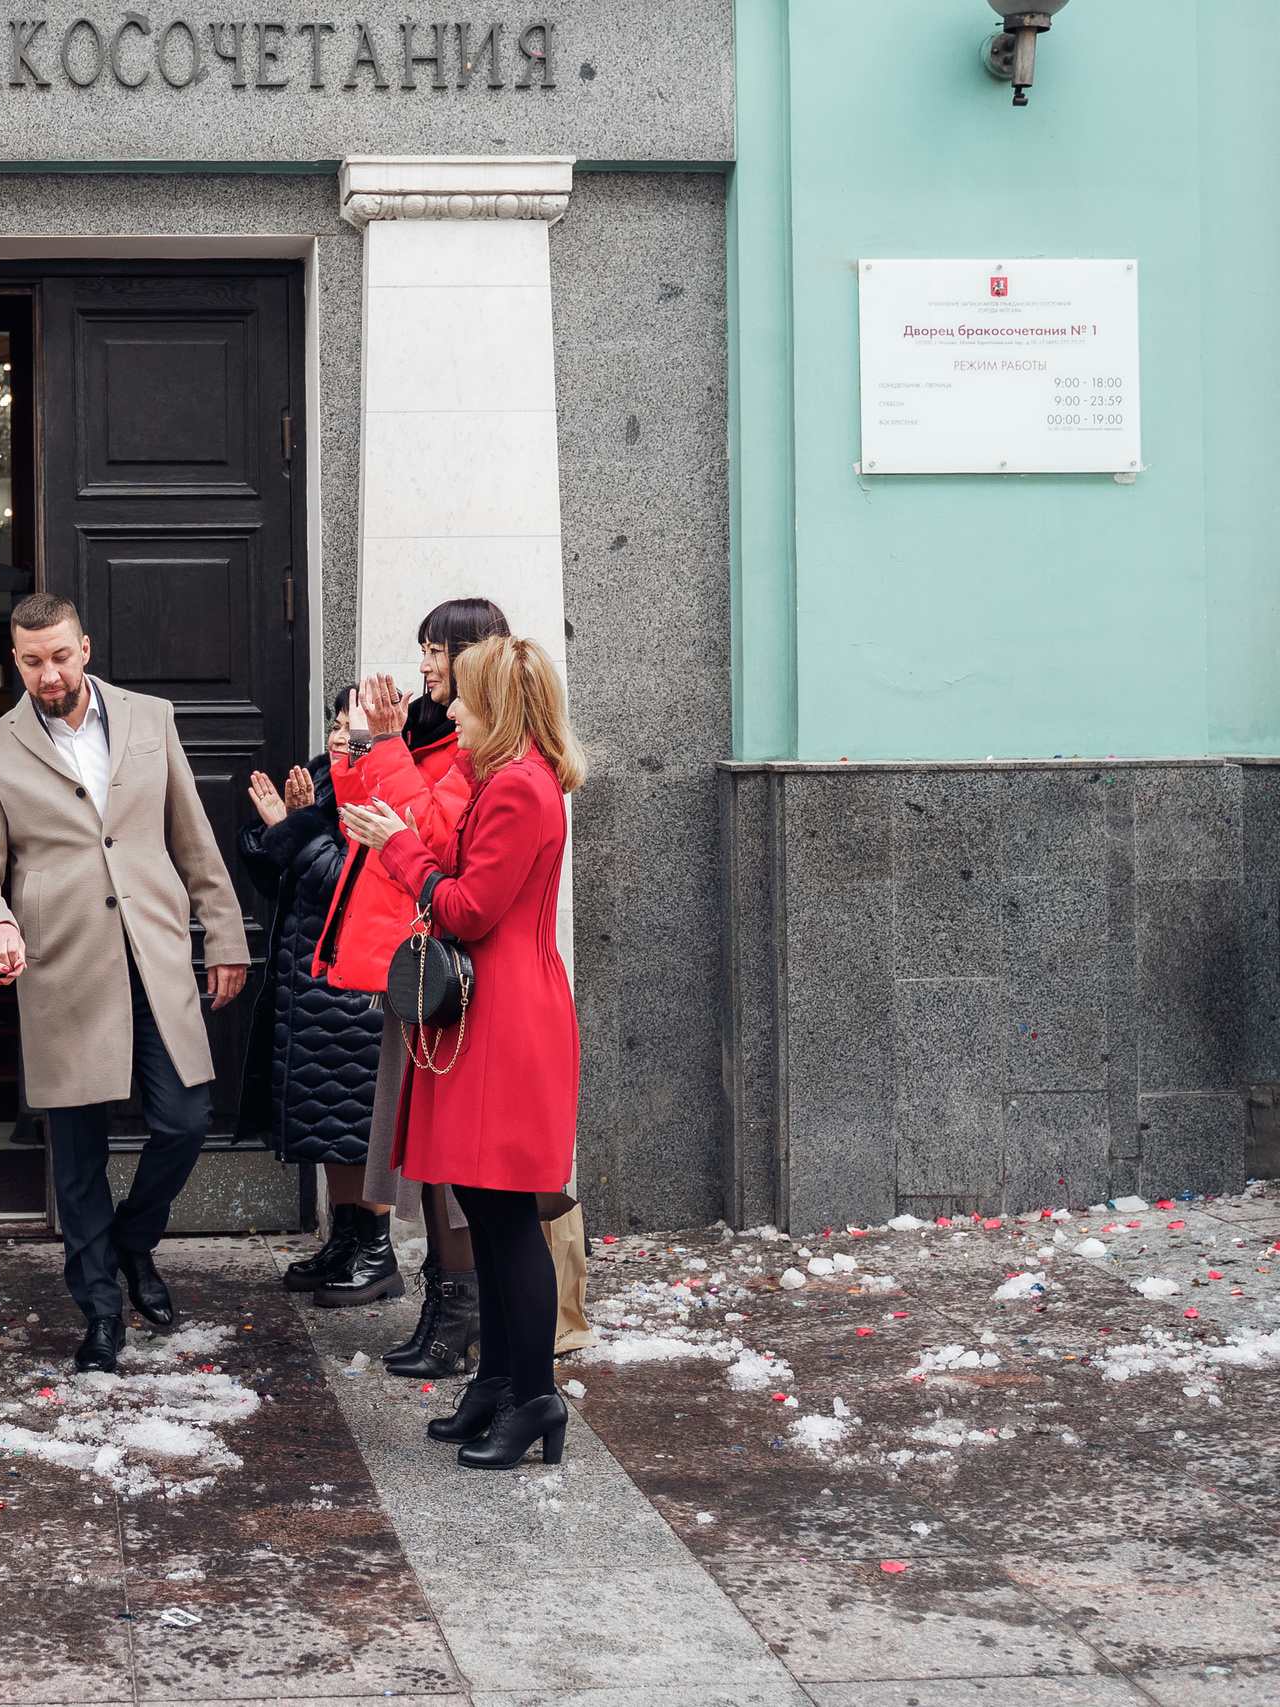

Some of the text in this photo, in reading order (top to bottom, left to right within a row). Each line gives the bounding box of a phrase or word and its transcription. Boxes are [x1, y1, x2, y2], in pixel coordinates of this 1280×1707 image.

[903, 325, 955, 340] Дворец
[957, 324, 1067, 340] бракосочетания
[1092, 325, 1098, 336] 1
[954, 360, 1047, 371] РЕЖИМ РАБОТЫ
[1054, 377, 1080, 388] 9:00
[1092, 377, 1122, 388] 18:00
[1054, 395, 1080, 406] 9:00
[1090, 395, 1123, 406] 23:59
[1047, 414, 1081, 425] 00:00
[1092, 414, 1123, 425] 19:00
